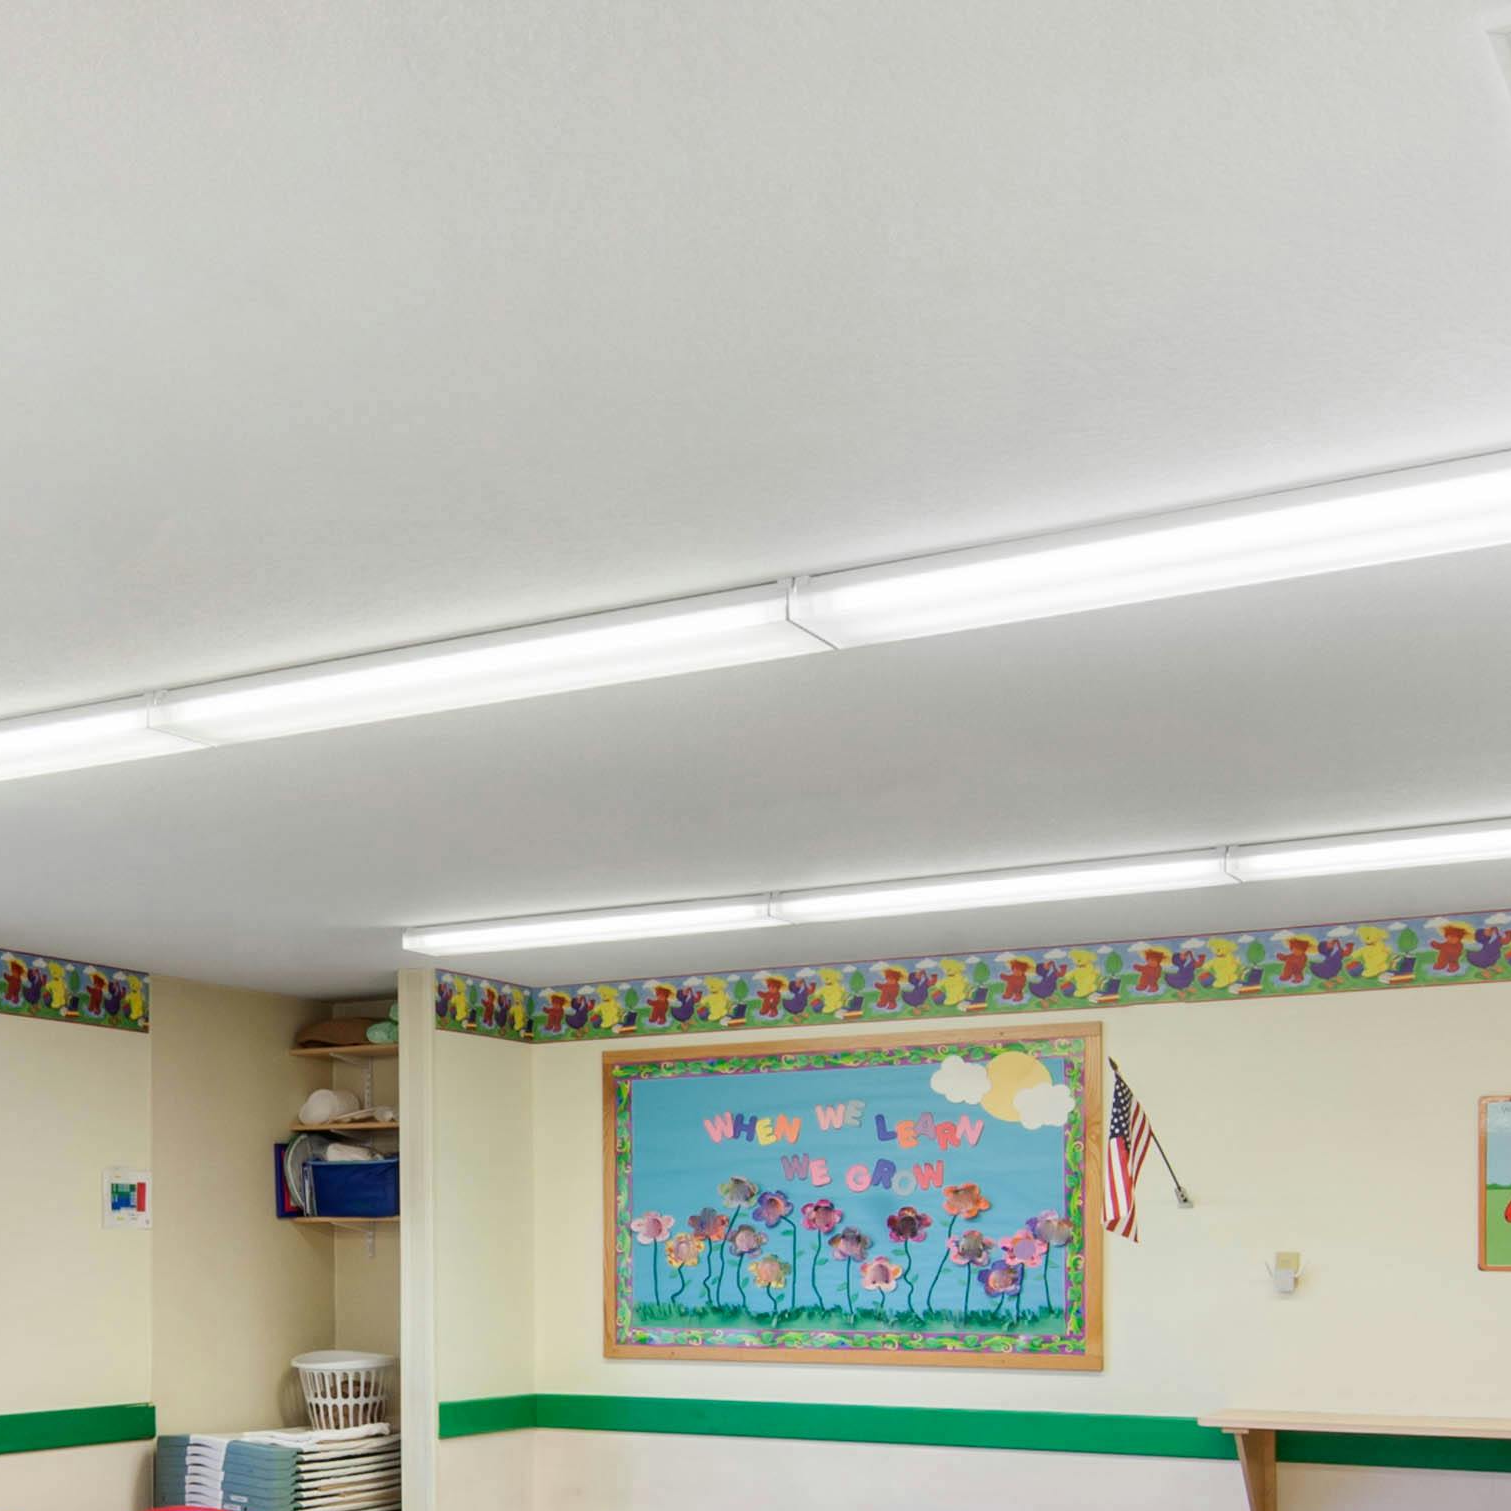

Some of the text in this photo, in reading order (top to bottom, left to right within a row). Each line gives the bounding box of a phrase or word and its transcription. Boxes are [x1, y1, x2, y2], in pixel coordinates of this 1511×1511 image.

[703, 1099, 985, 1151] WHEN WE LEARN
[780, 1153, 945, 1196] WE GROW
